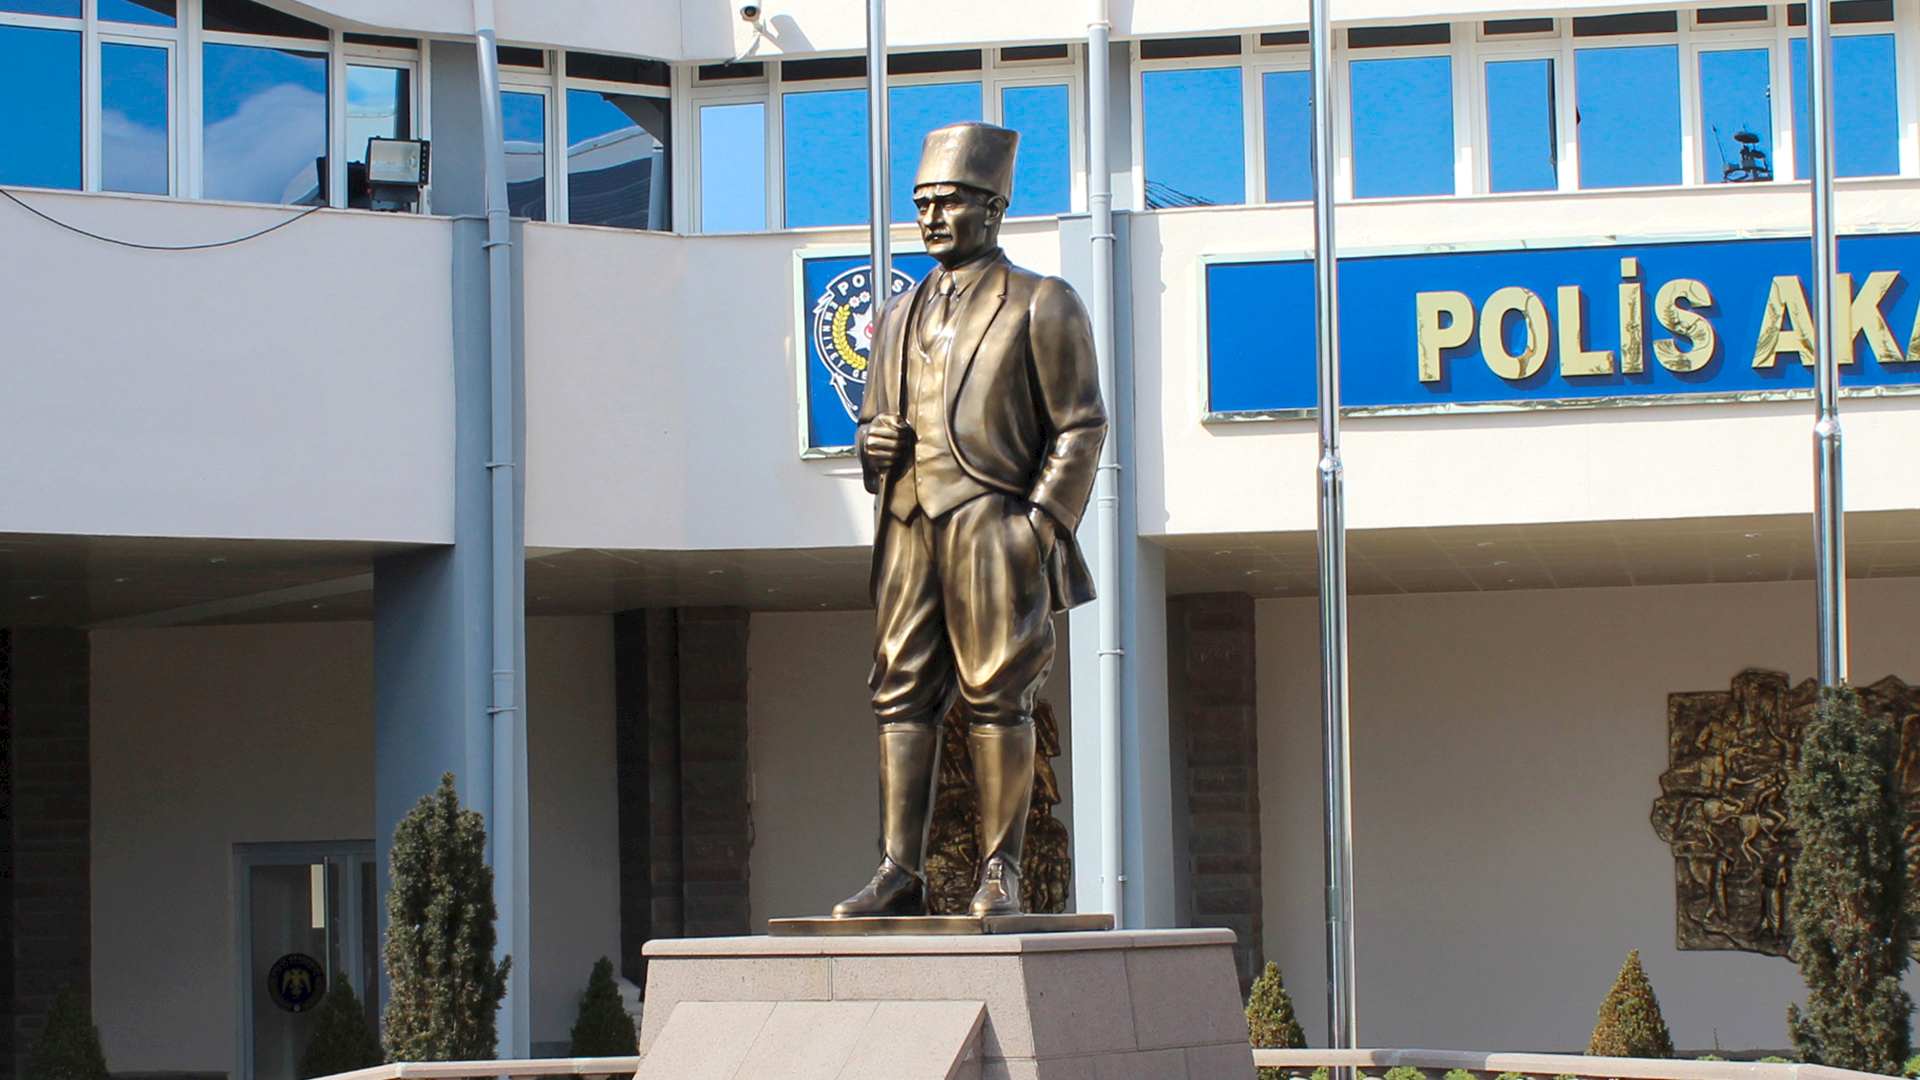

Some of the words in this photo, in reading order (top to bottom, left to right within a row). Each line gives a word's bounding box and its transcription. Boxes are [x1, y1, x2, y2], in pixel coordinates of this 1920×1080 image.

[837, 274, 904, 296] POS
[1416, 257, 1716, 382] POLİS
[1752, 271, 1920, 367] AK
